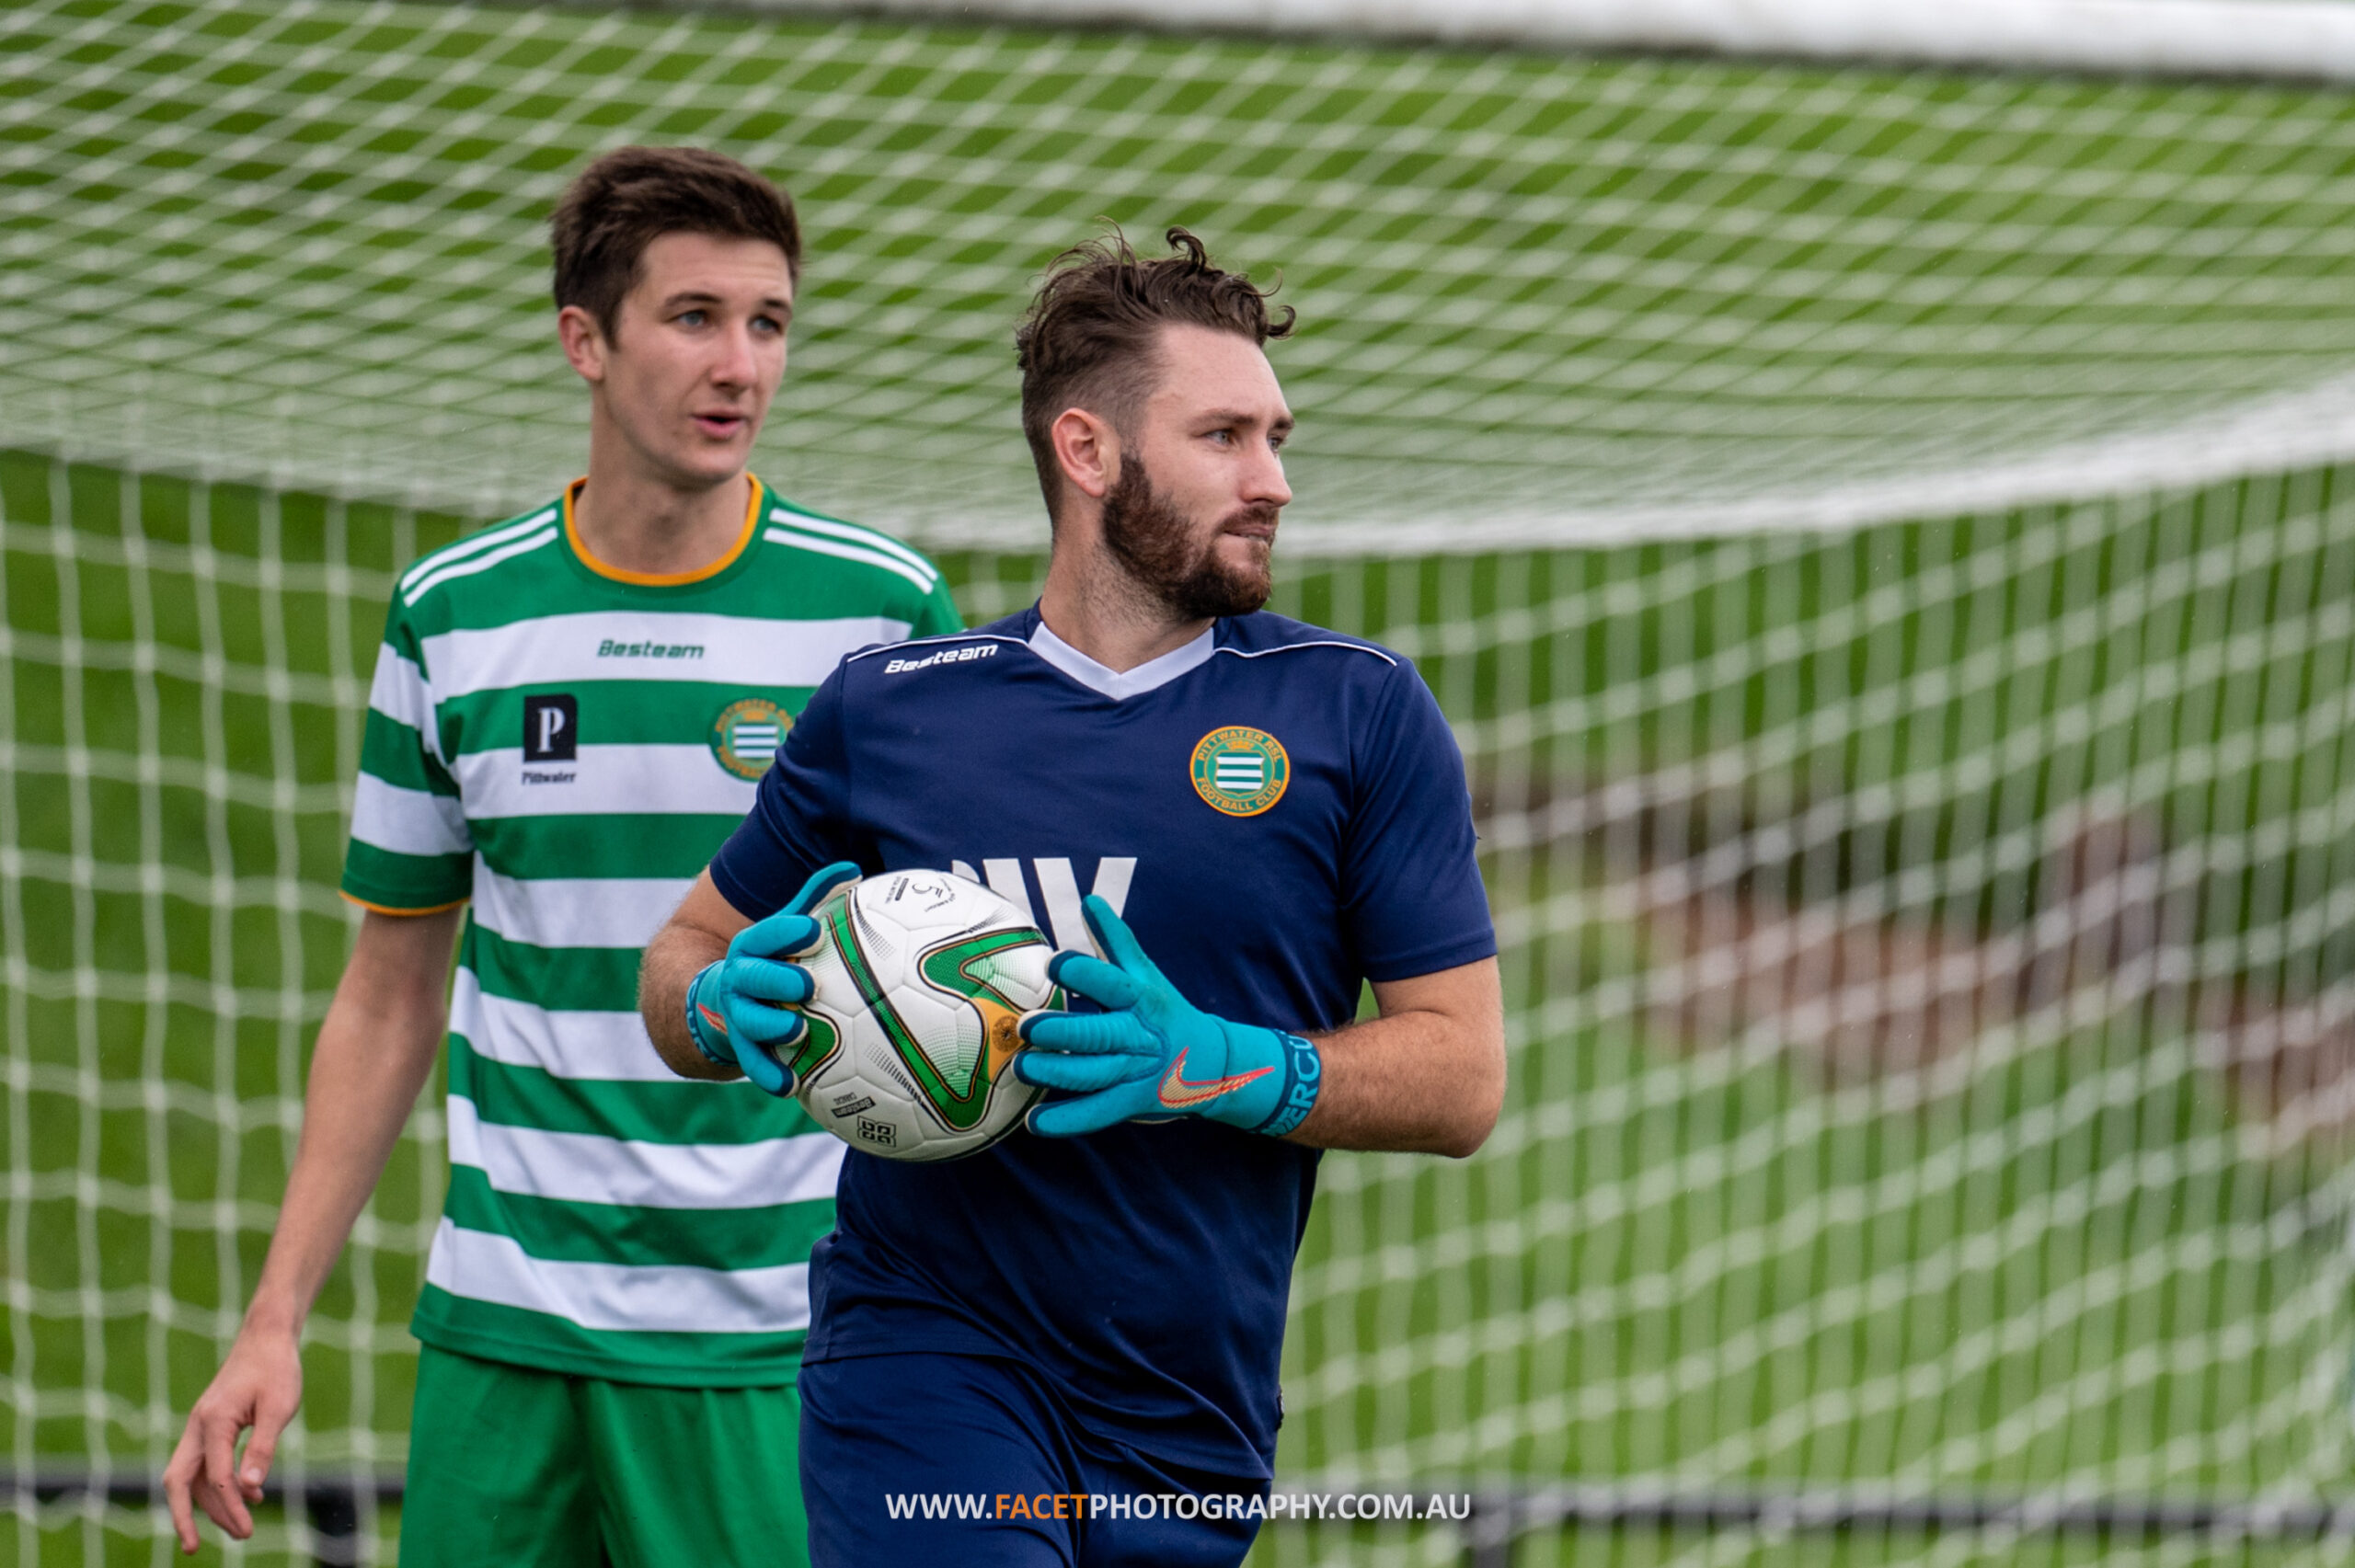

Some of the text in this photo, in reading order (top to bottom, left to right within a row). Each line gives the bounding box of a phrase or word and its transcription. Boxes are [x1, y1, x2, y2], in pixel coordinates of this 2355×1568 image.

[597, 639, 705, 659] Besteam
[884, 644, 998, 674] Besteam
[537, 706, 566, 752] P
[1197, 729, 1282, 763] PITTWATER RSL
[1197, 778, 1281, 811] FOOTBALL CLUB
[1260, 1032, 1320, 1137] MERCU
